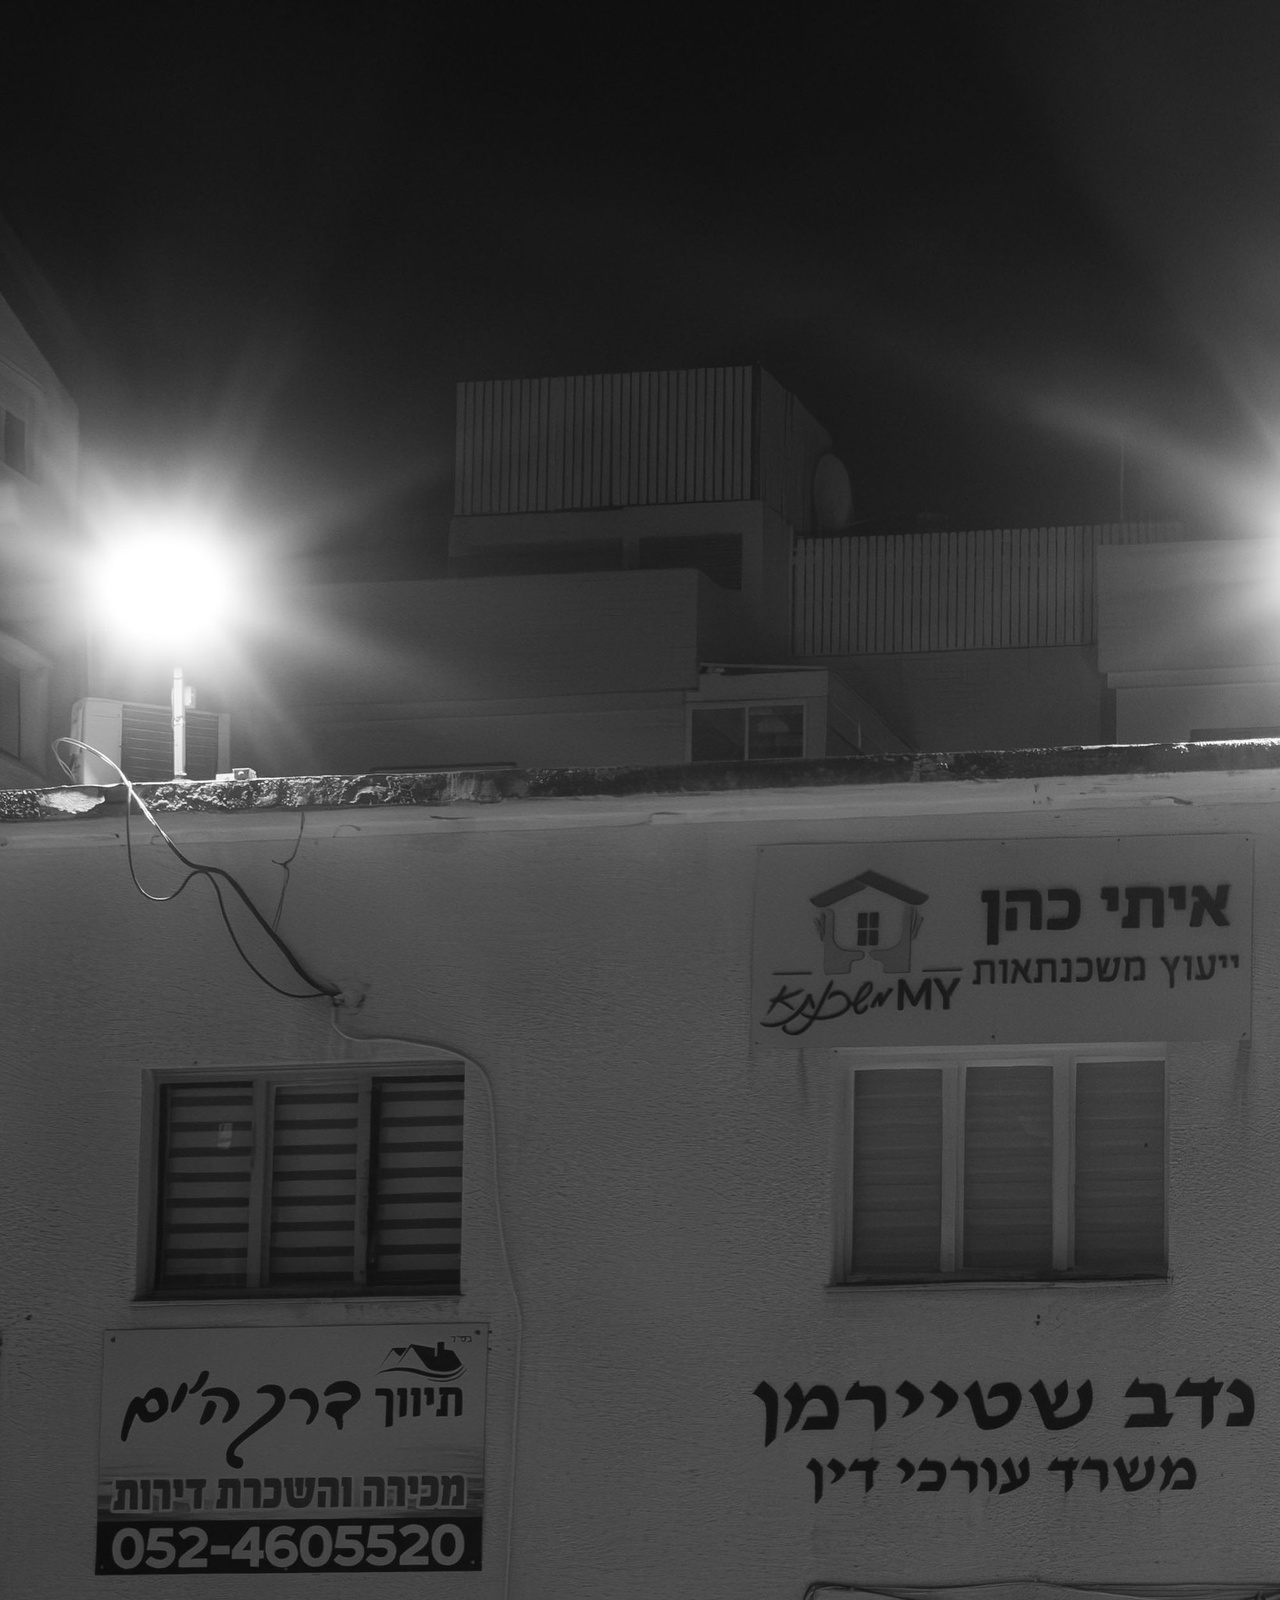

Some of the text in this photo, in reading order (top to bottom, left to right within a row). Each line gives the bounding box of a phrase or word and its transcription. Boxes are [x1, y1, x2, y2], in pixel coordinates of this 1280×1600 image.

[981, 884, 1231, 945] איתי כהן
[897, 977, 961, 1010] MY
[972, 954, 1240, 988] ייעוץ משכנתאות
[226, 1380, 361, 1469] דרך
[375, 1386, 463, 1427] תיווך
[752, 1376, 1255, 1447] נדב שטיירמן
[113, 1475, 464, 1510] מכירה והשכרת דירות
[806, 1456, 1197, 1503] משרד עורכי דין
[112, 1524, 465, 1569] 052-4605520
